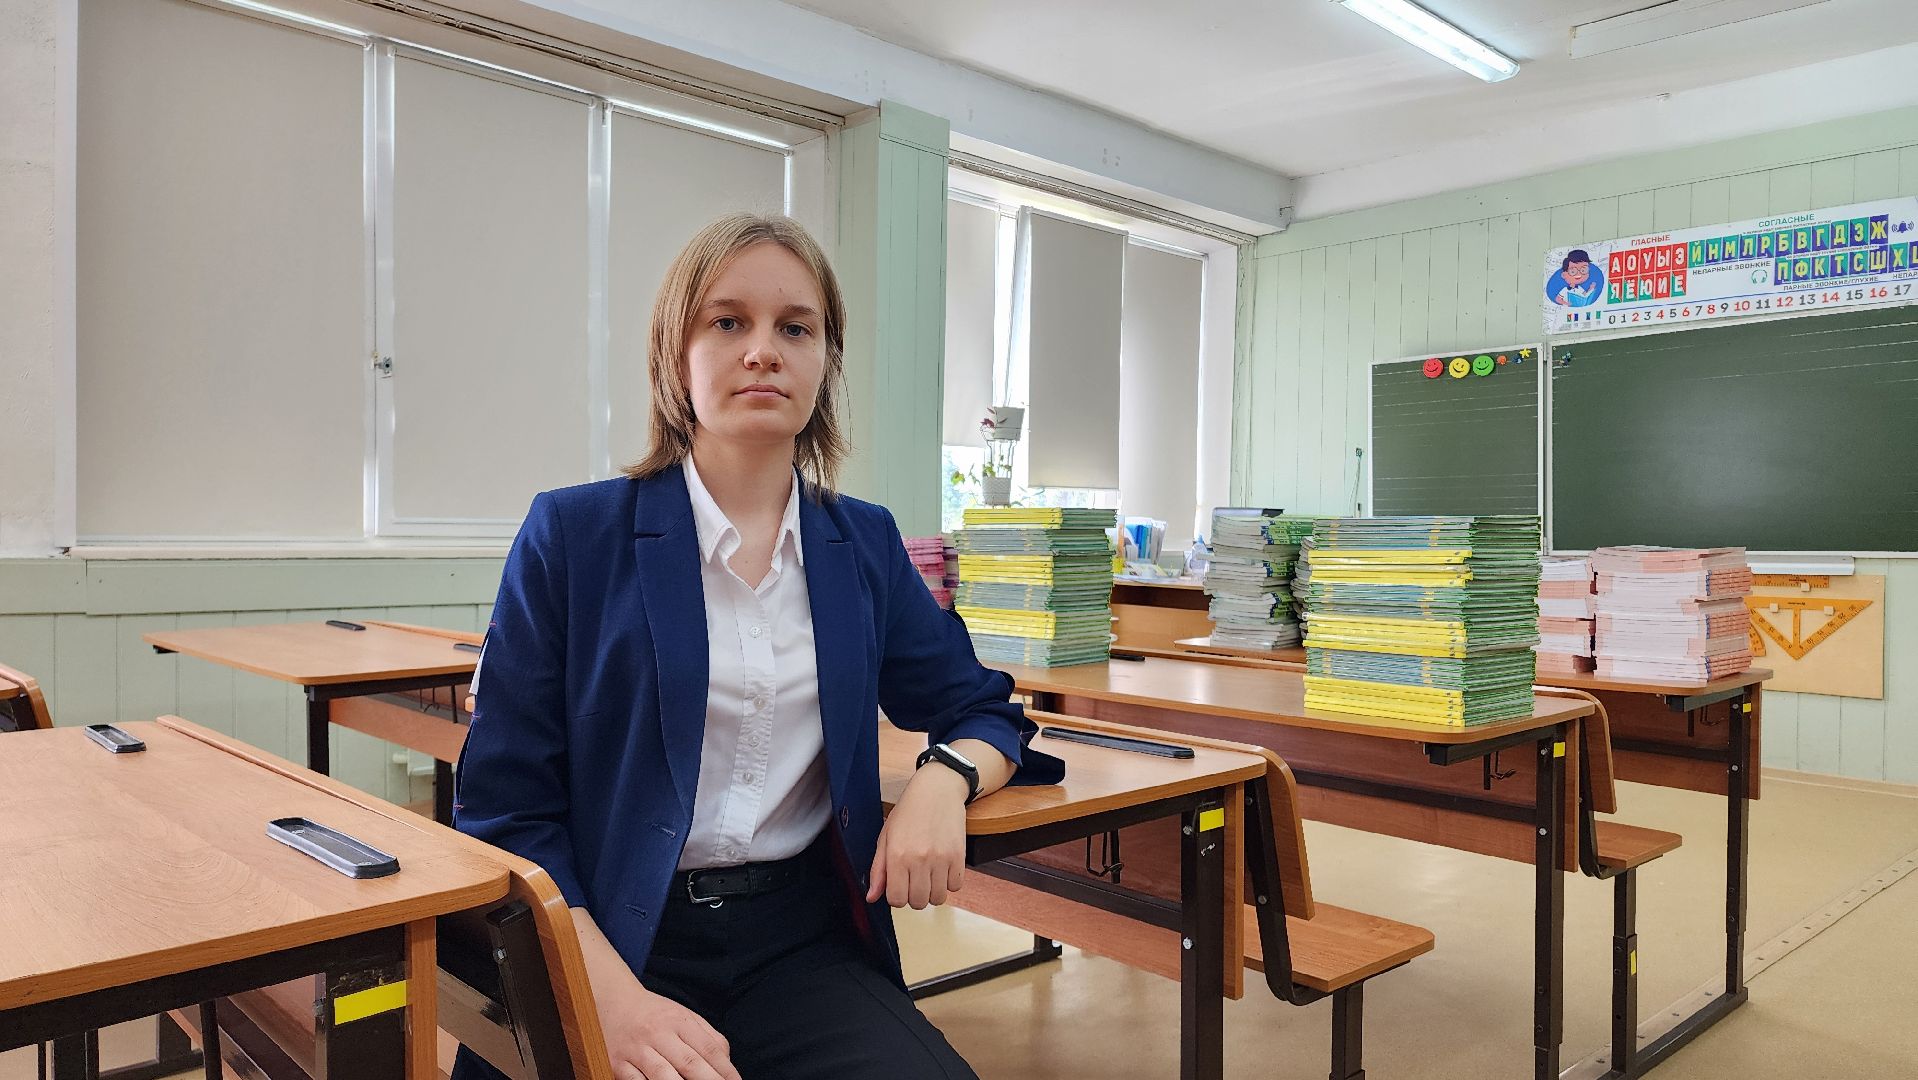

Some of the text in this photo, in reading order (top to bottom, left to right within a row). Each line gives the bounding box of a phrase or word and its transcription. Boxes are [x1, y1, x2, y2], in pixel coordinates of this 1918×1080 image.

[1759, 214, 1814, 228] СОГЛАСНЫЕ
[1631, 234, 1670, 246] ГЛАСНЫЕ
[1692, 261, 1771, 276] НЕПАРНЫЕ ЗВОНКИЕ
[1784, 282, 1813, 291] ПАРНЫЕ
[1609, 284, 1911, 324] 0 1 2 3 4 5 6 7 8 9 10 11 12 13 14 15 16 17
